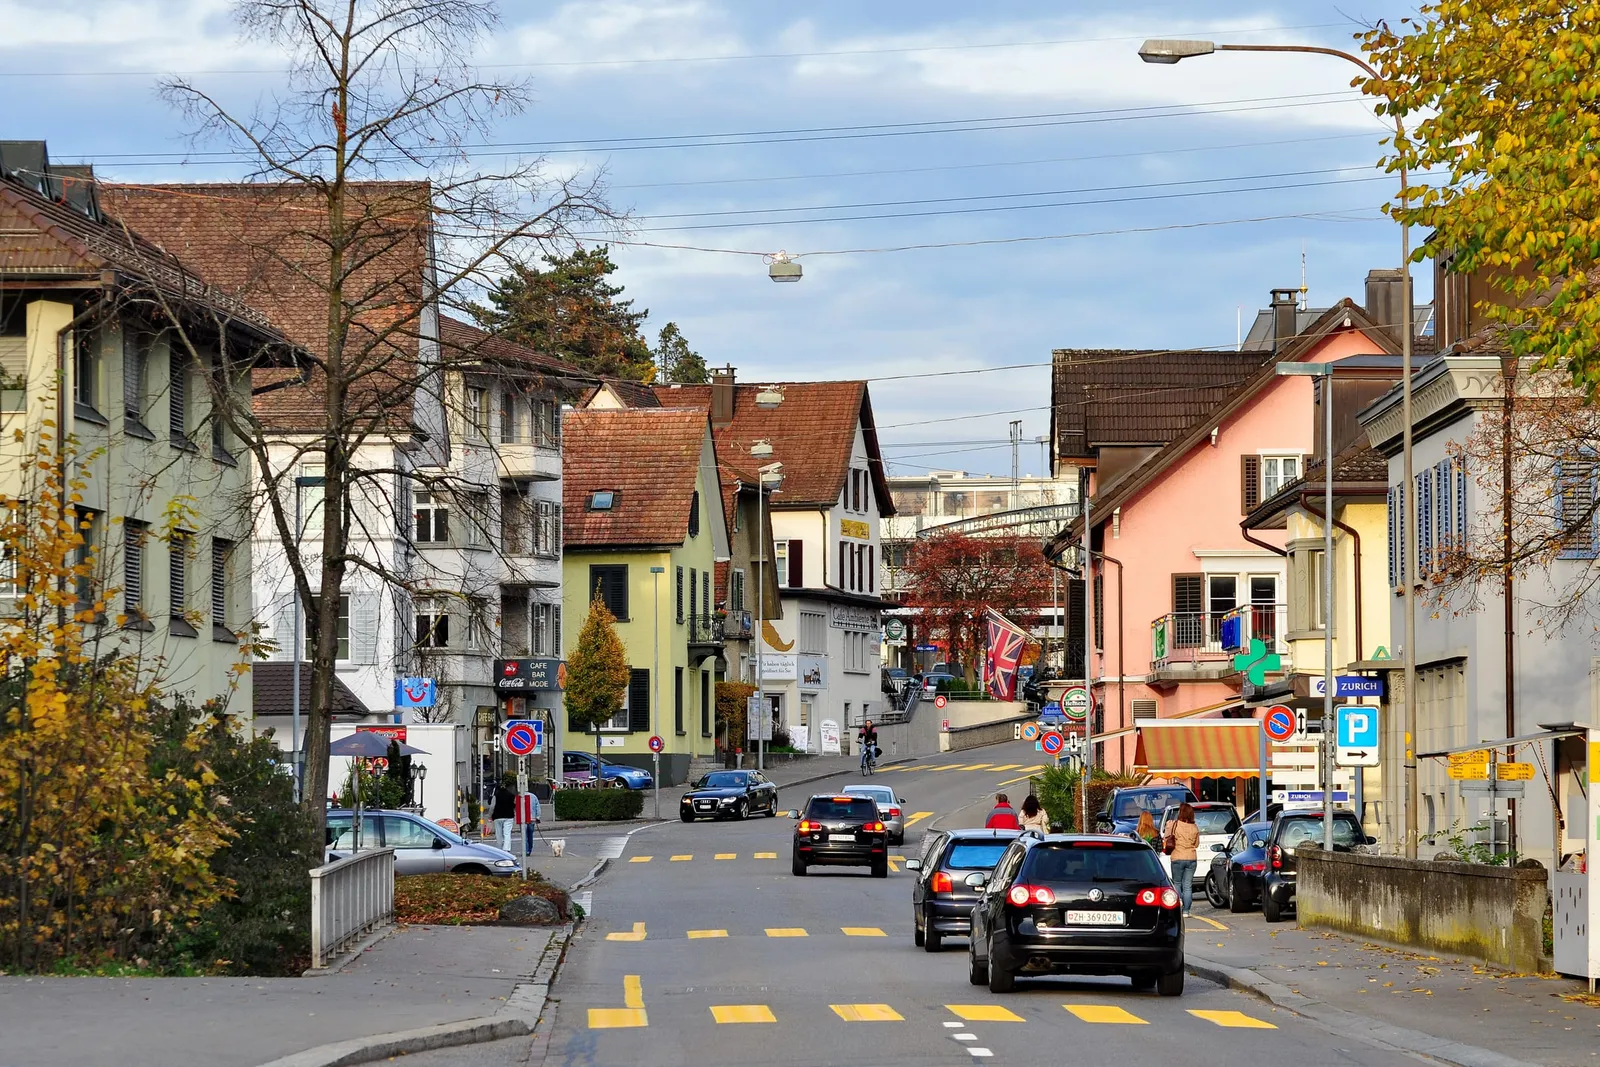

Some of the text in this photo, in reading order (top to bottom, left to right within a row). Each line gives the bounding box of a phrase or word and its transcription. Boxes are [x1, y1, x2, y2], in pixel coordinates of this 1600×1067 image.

[1341, 682, 1377, 690] ZURICH
[1347, 713, 1369, 743] P
[1073, 913, 1084, 922] ZH
